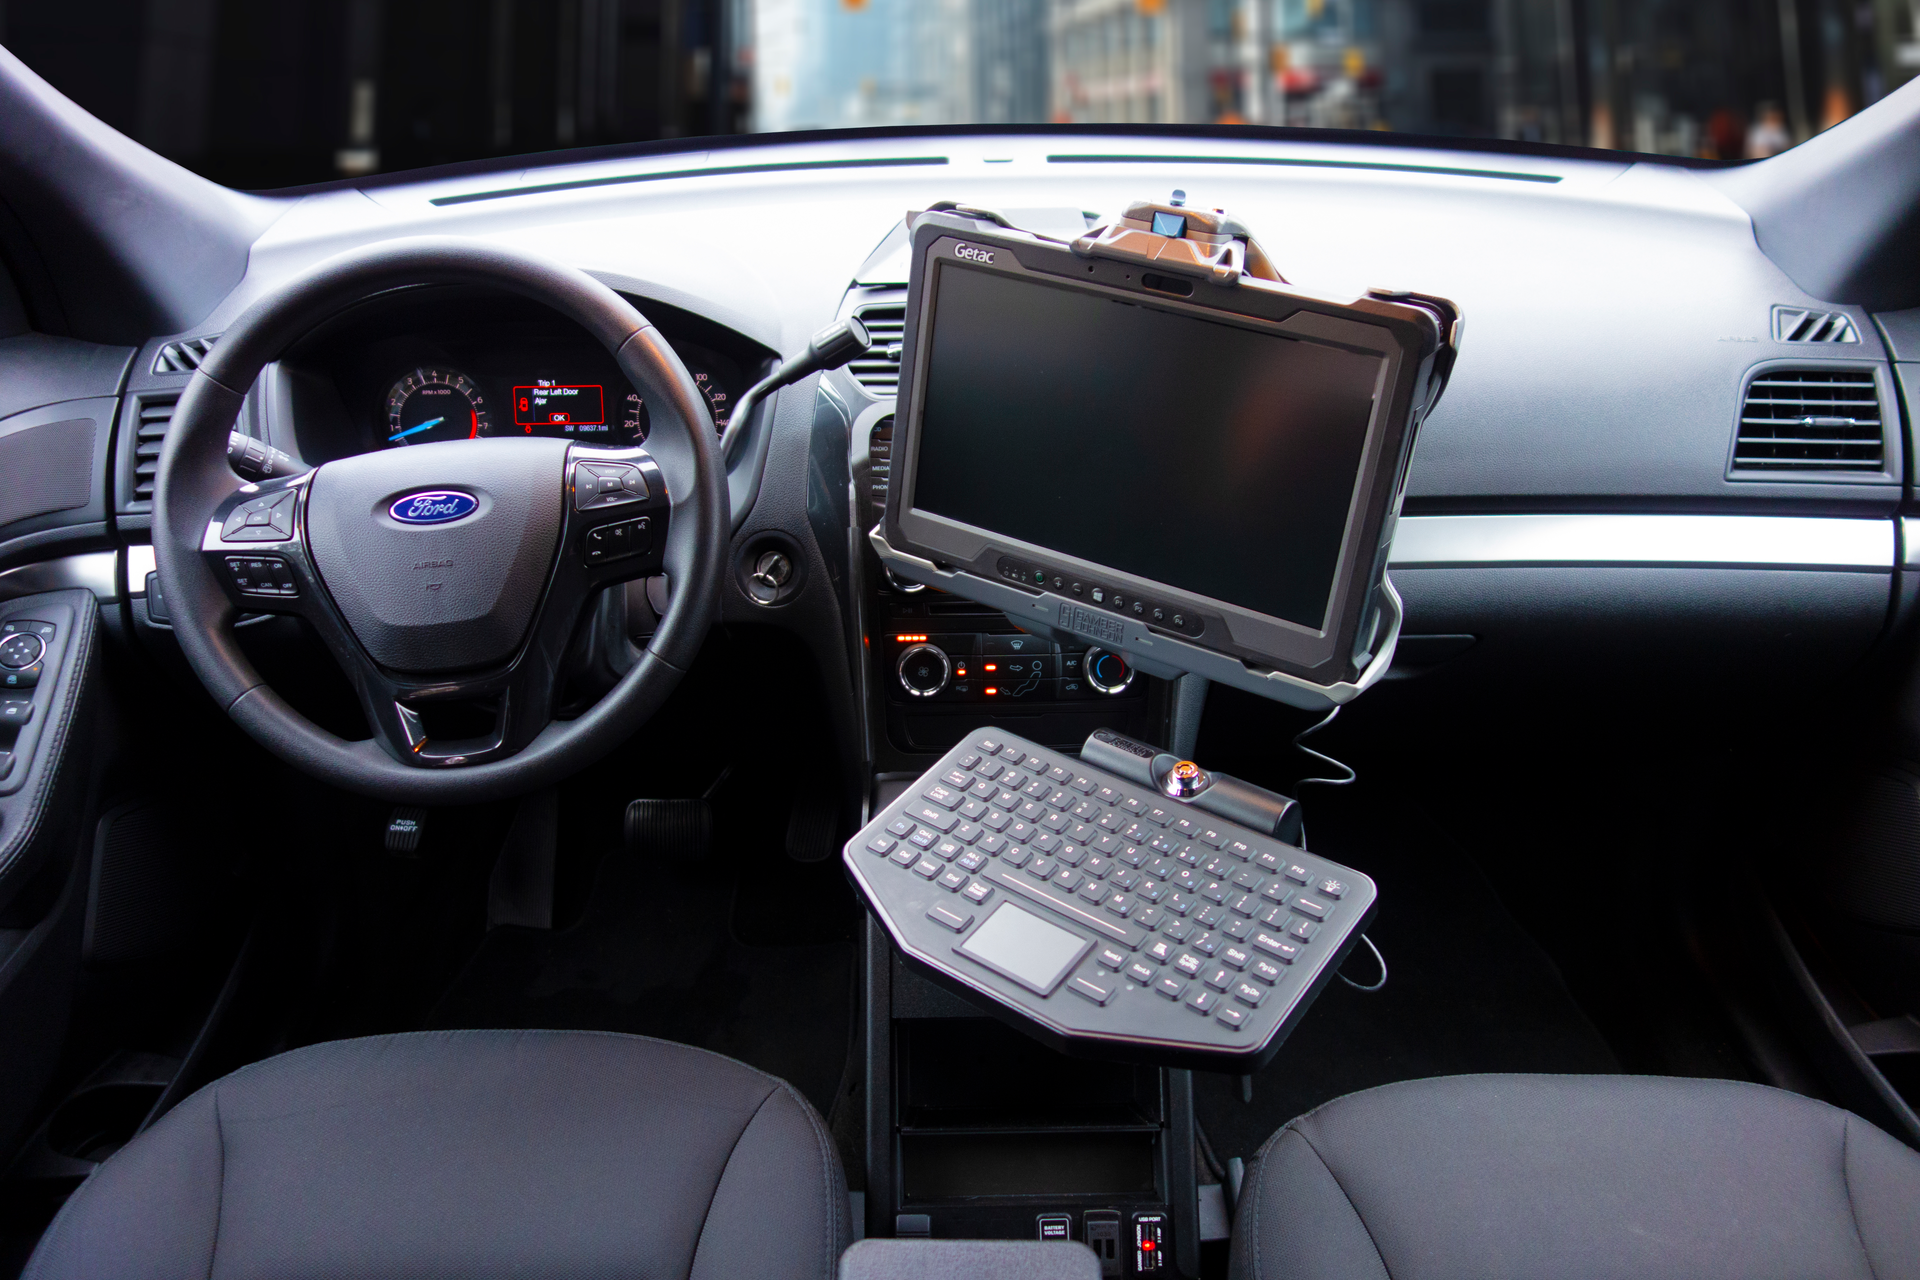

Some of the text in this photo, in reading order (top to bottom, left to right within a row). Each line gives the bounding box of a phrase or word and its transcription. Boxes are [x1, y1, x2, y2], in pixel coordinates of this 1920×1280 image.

[954, 243, 995, 264] Getac
[390, 398, 396, 406] 2
[477, 396, 483, 404] 6
[534, 397, 547, 405] Ajar
[390, 424, 394, 432] 1
[408, 495, 459, 517] Ford
[1134, 605, 1143, 613] P2
[1154, 611, 1163, 619] P3
[1075, 608, 1124, 634] GAMBER
[1174, 617, 1183, 625] P4
[1075, 621, 1123, 644] JOHNSON
[923, 809, 939, 819] Shift
[1234, 842, 1247, 850] F10
[921, 861, 935, 870] Home
[1292, 865, 1305, 874] F12
[946, 873, 960, 882] End
[1258, 934, 1281, 947] Enter
[1227, 948, 1246, 961] Shift
